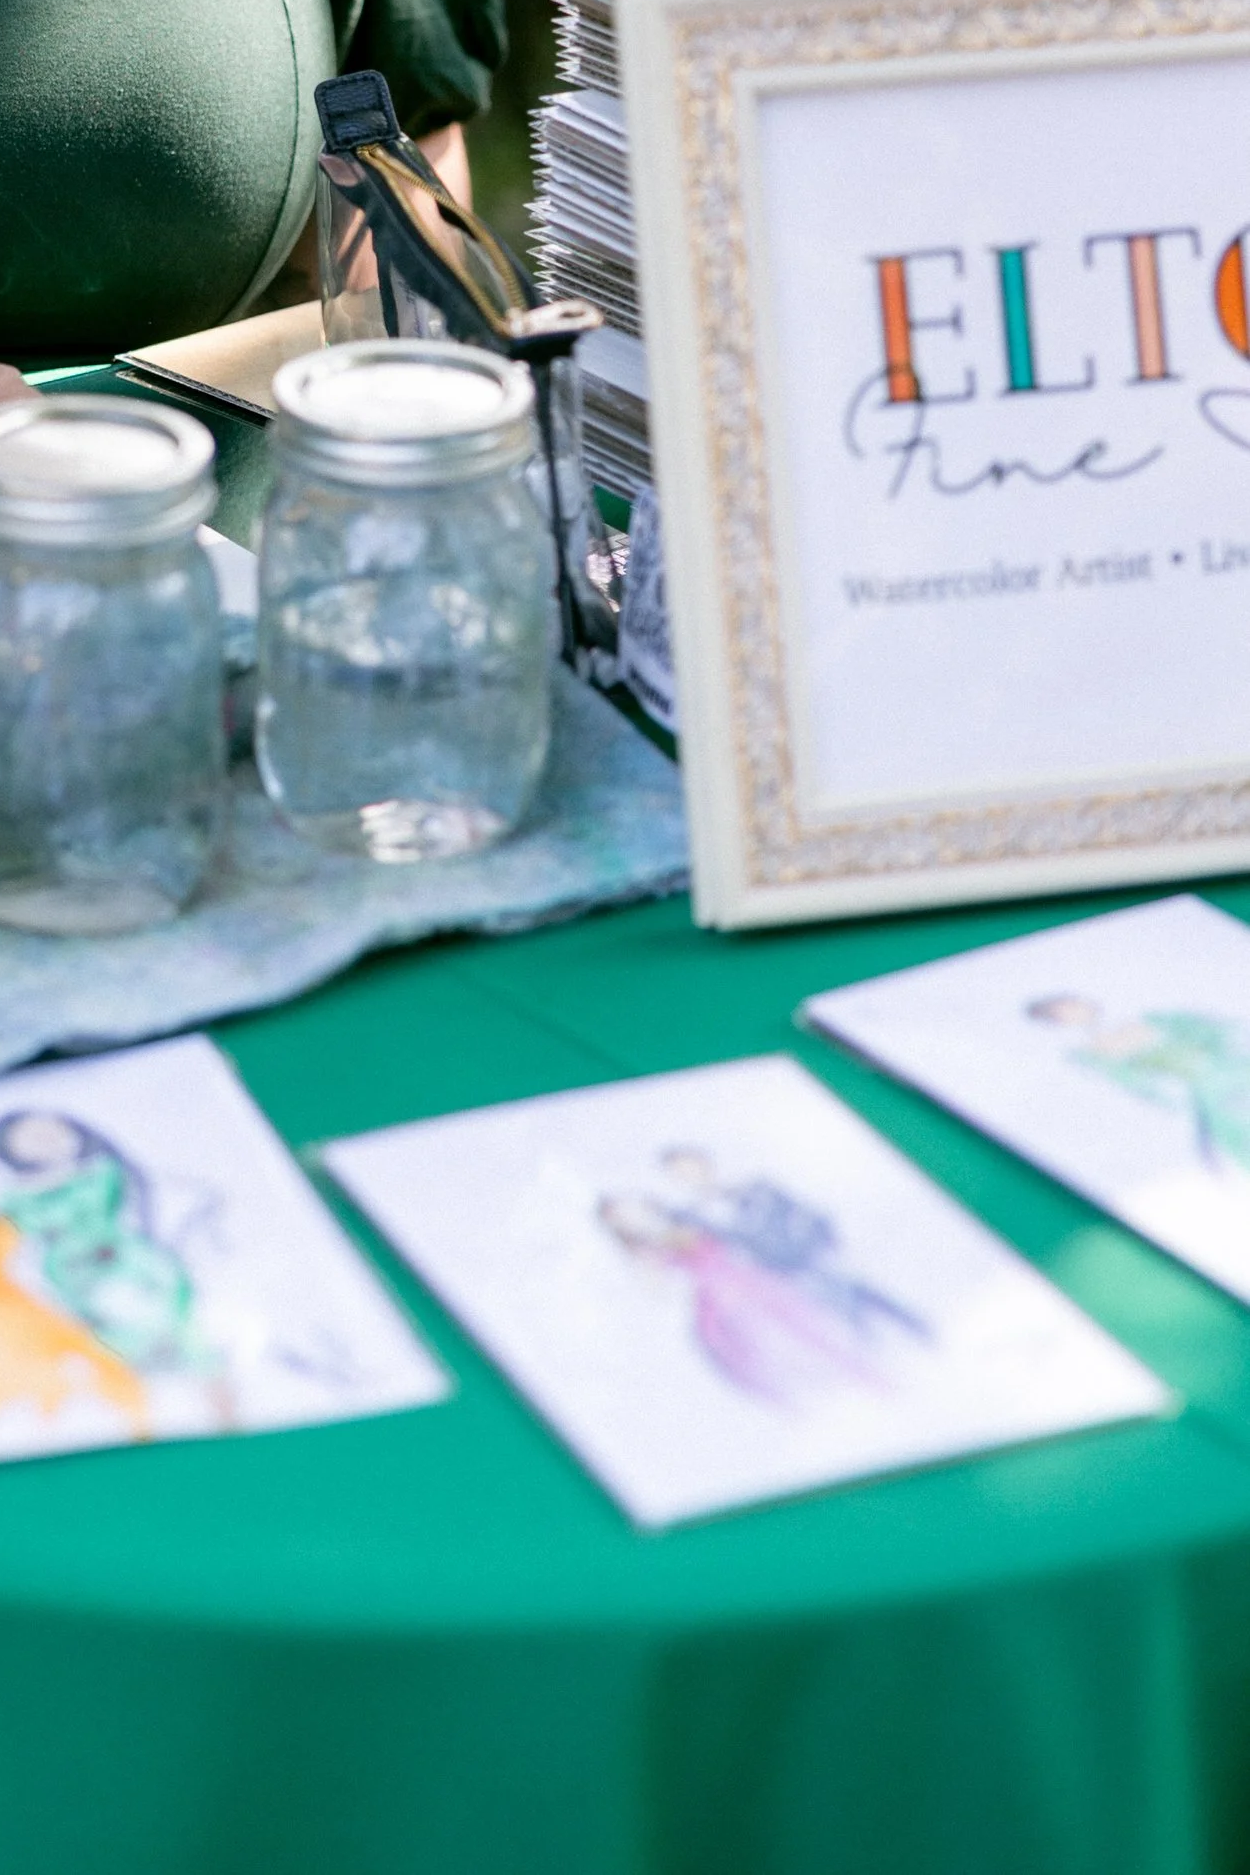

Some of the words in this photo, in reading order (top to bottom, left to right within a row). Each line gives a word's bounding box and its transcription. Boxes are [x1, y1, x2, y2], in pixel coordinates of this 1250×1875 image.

[866, 223, 1250, 409] ELT
[844, 367, 1164, 501] Fine
[843, 557, 1041, 607] Watercolor
[1059, 549, 1151, 588] Artist
